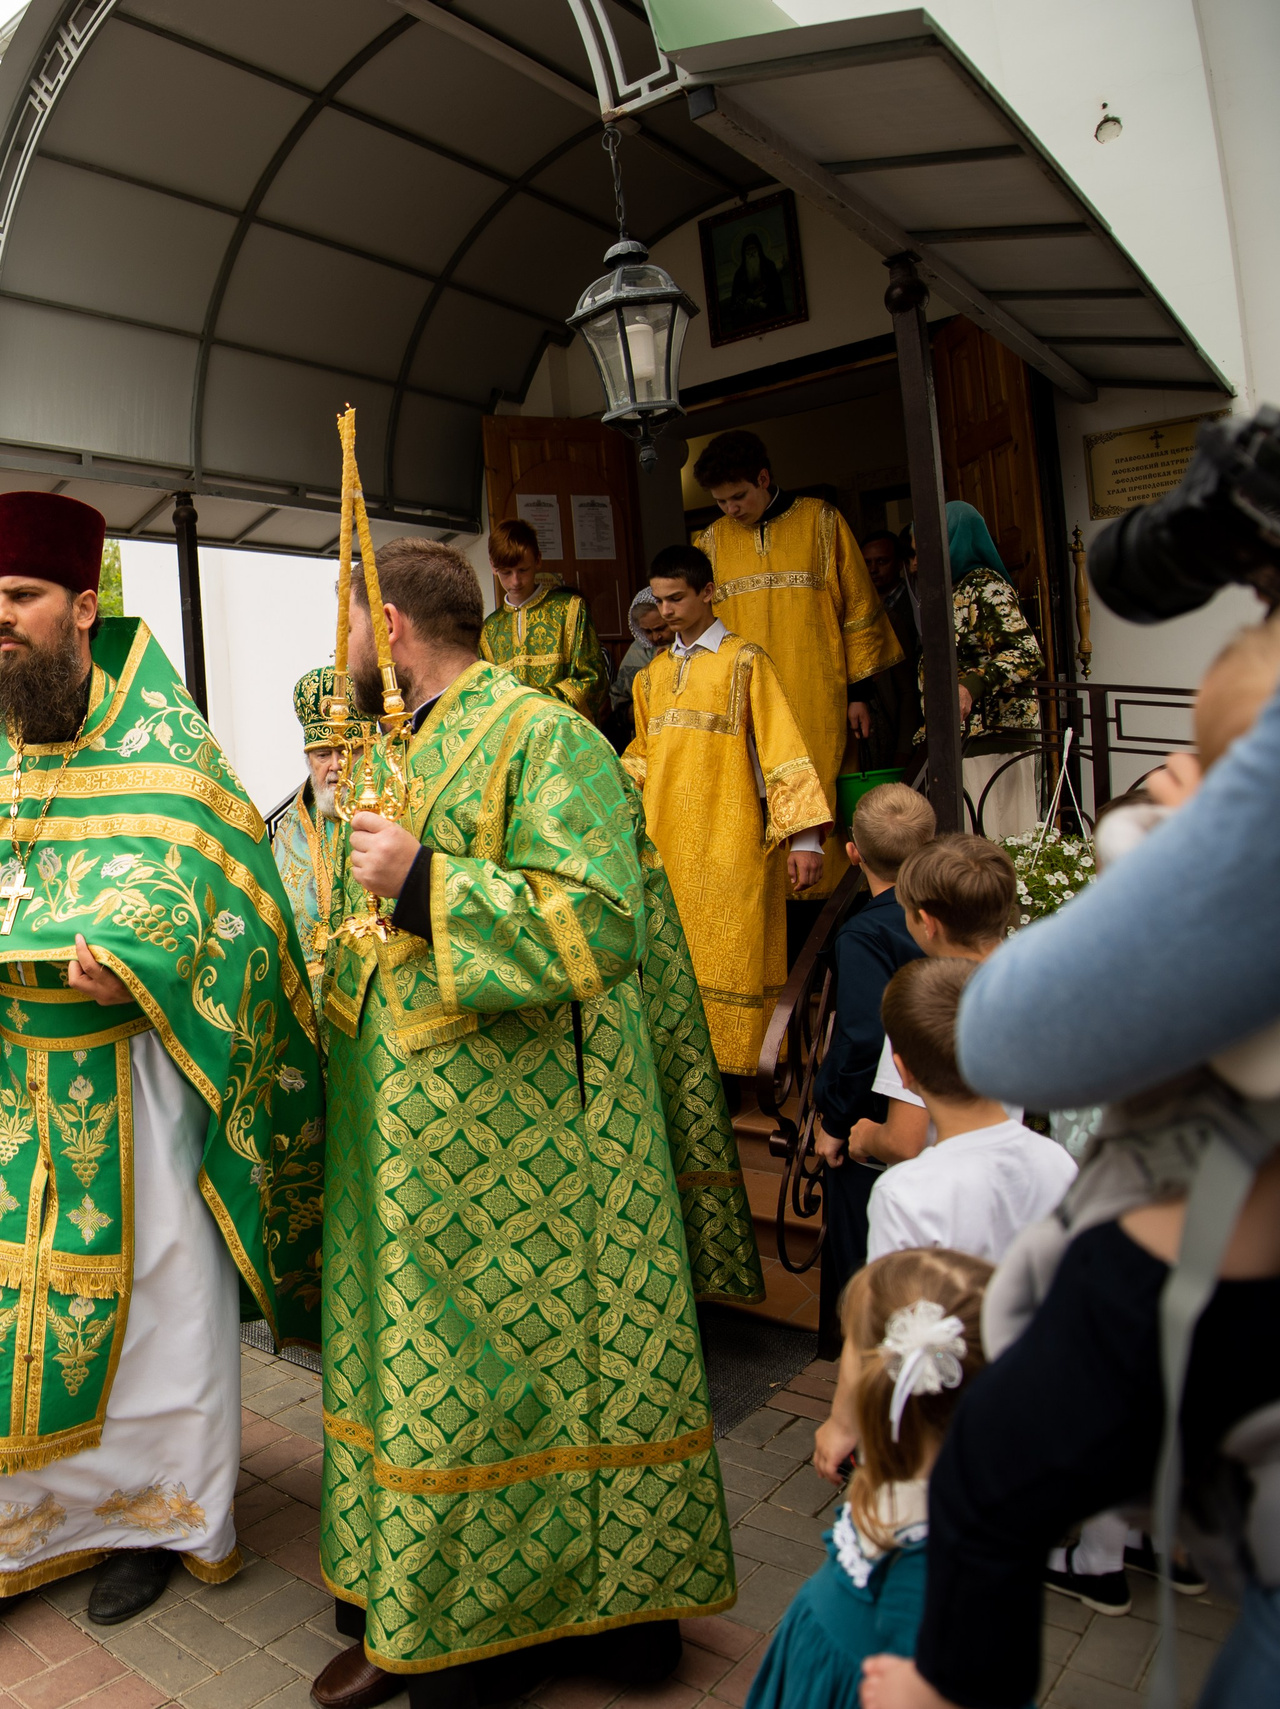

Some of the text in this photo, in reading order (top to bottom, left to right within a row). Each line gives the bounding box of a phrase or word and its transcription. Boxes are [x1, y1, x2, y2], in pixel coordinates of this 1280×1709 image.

[1115, 450, 1169, 464] ПРАВОСЛАВНАЯ
[1111, 461, 1159, 475] МОСКОВСКИЙ
[1115, 467, 1190, 484] ФЕОДОСИЙСКАЯ ЕПА
[1107, 478, 1182, 496] ХРАМ ПРЕПОДОБНОГО
[1127, 494, 1150, 502] КИЕВО
